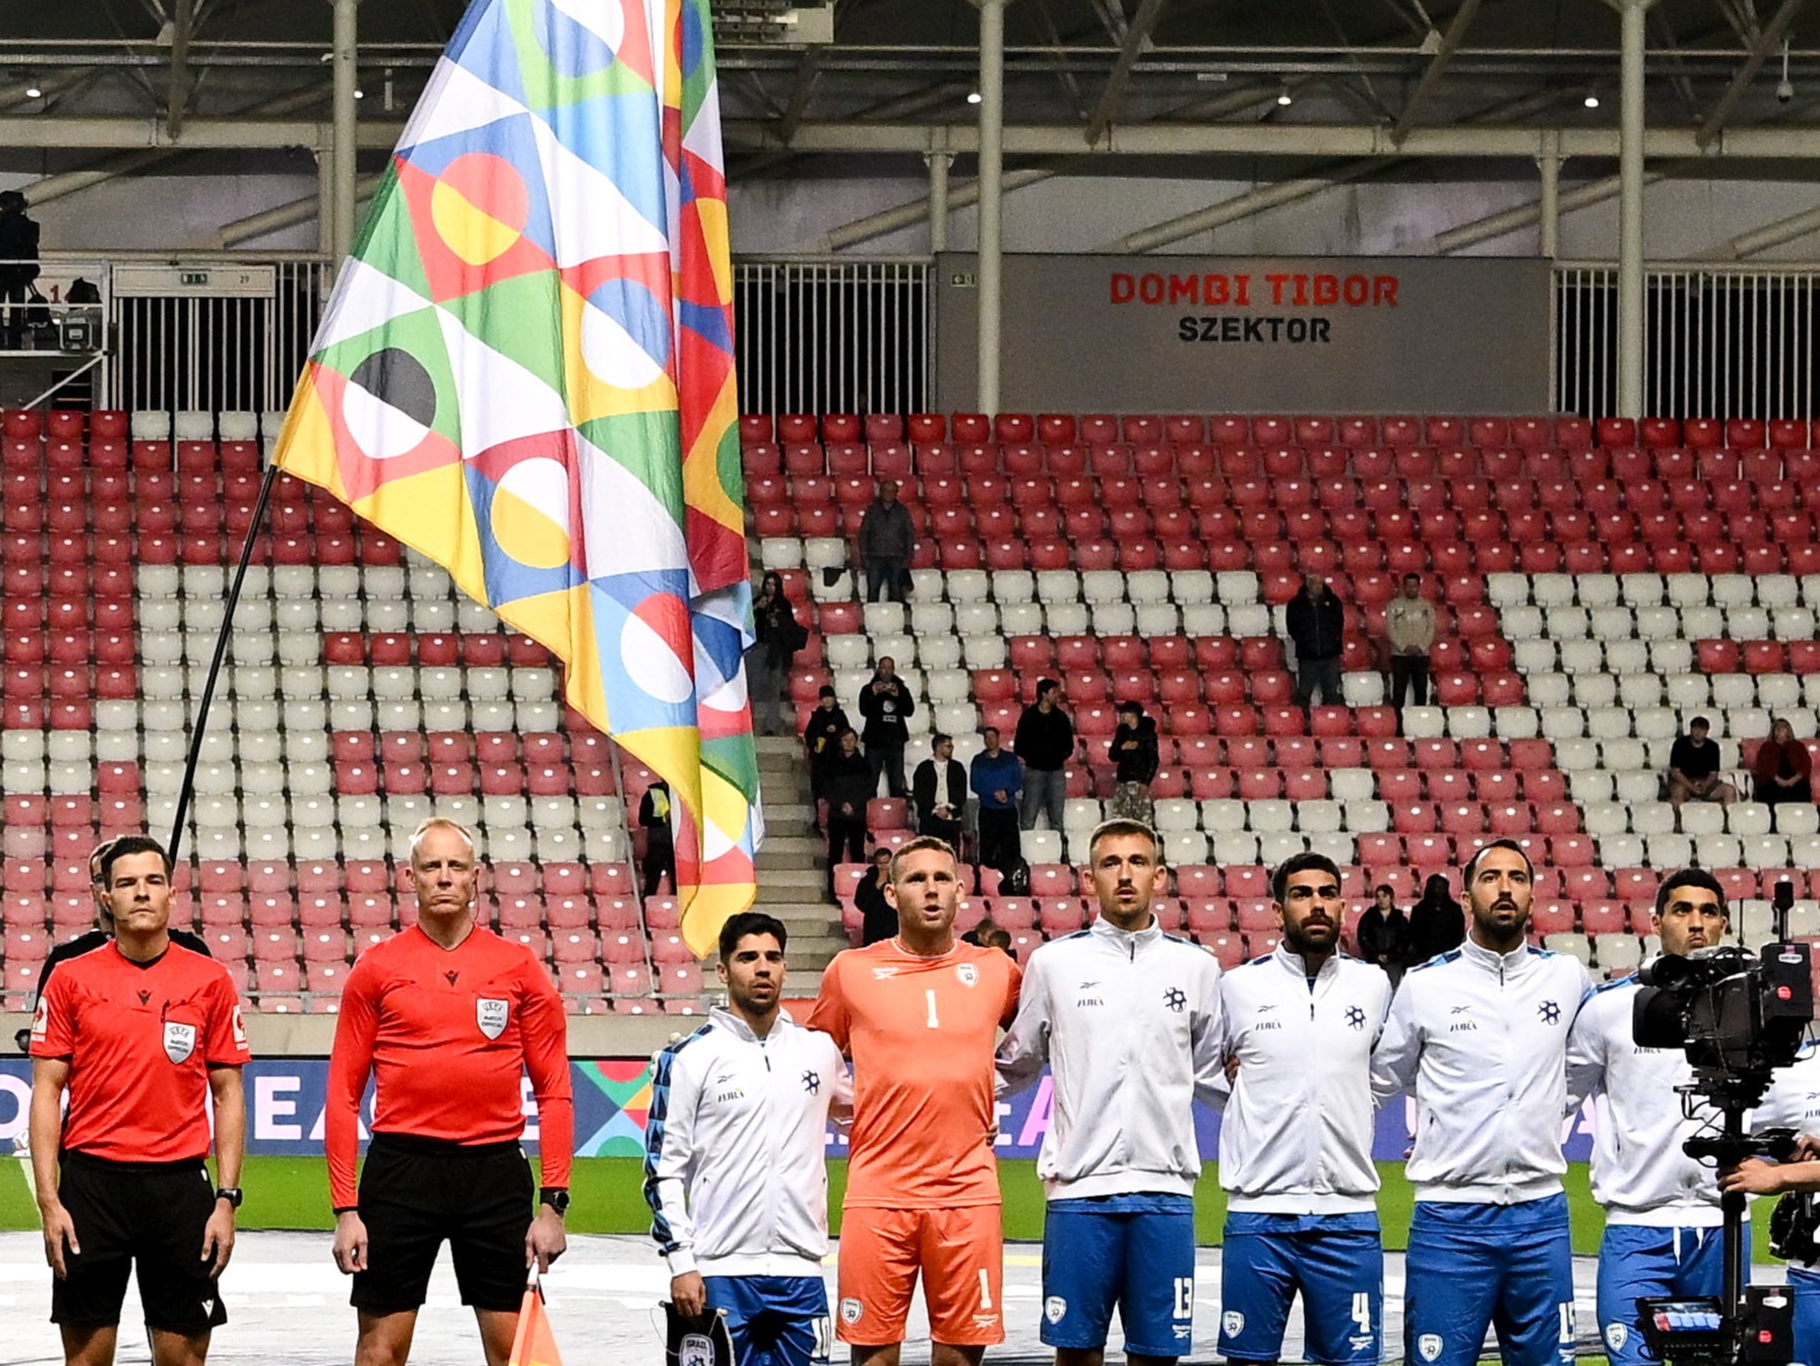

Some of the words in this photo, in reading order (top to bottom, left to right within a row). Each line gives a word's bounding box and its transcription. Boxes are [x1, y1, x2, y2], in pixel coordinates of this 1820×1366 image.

[1110, 272, 1250, 306] DOMBI
[1265, 272, 1400, 308] TIBOR
[1178, 315, 1331, 344] SZEKTOR
[925, 989, 939, 1029] 1
[978, 1268, 992, 1309] 1
[1173, 1277, 1193, 1320] 13
[1351, 1292, 1371, 1334] 4
